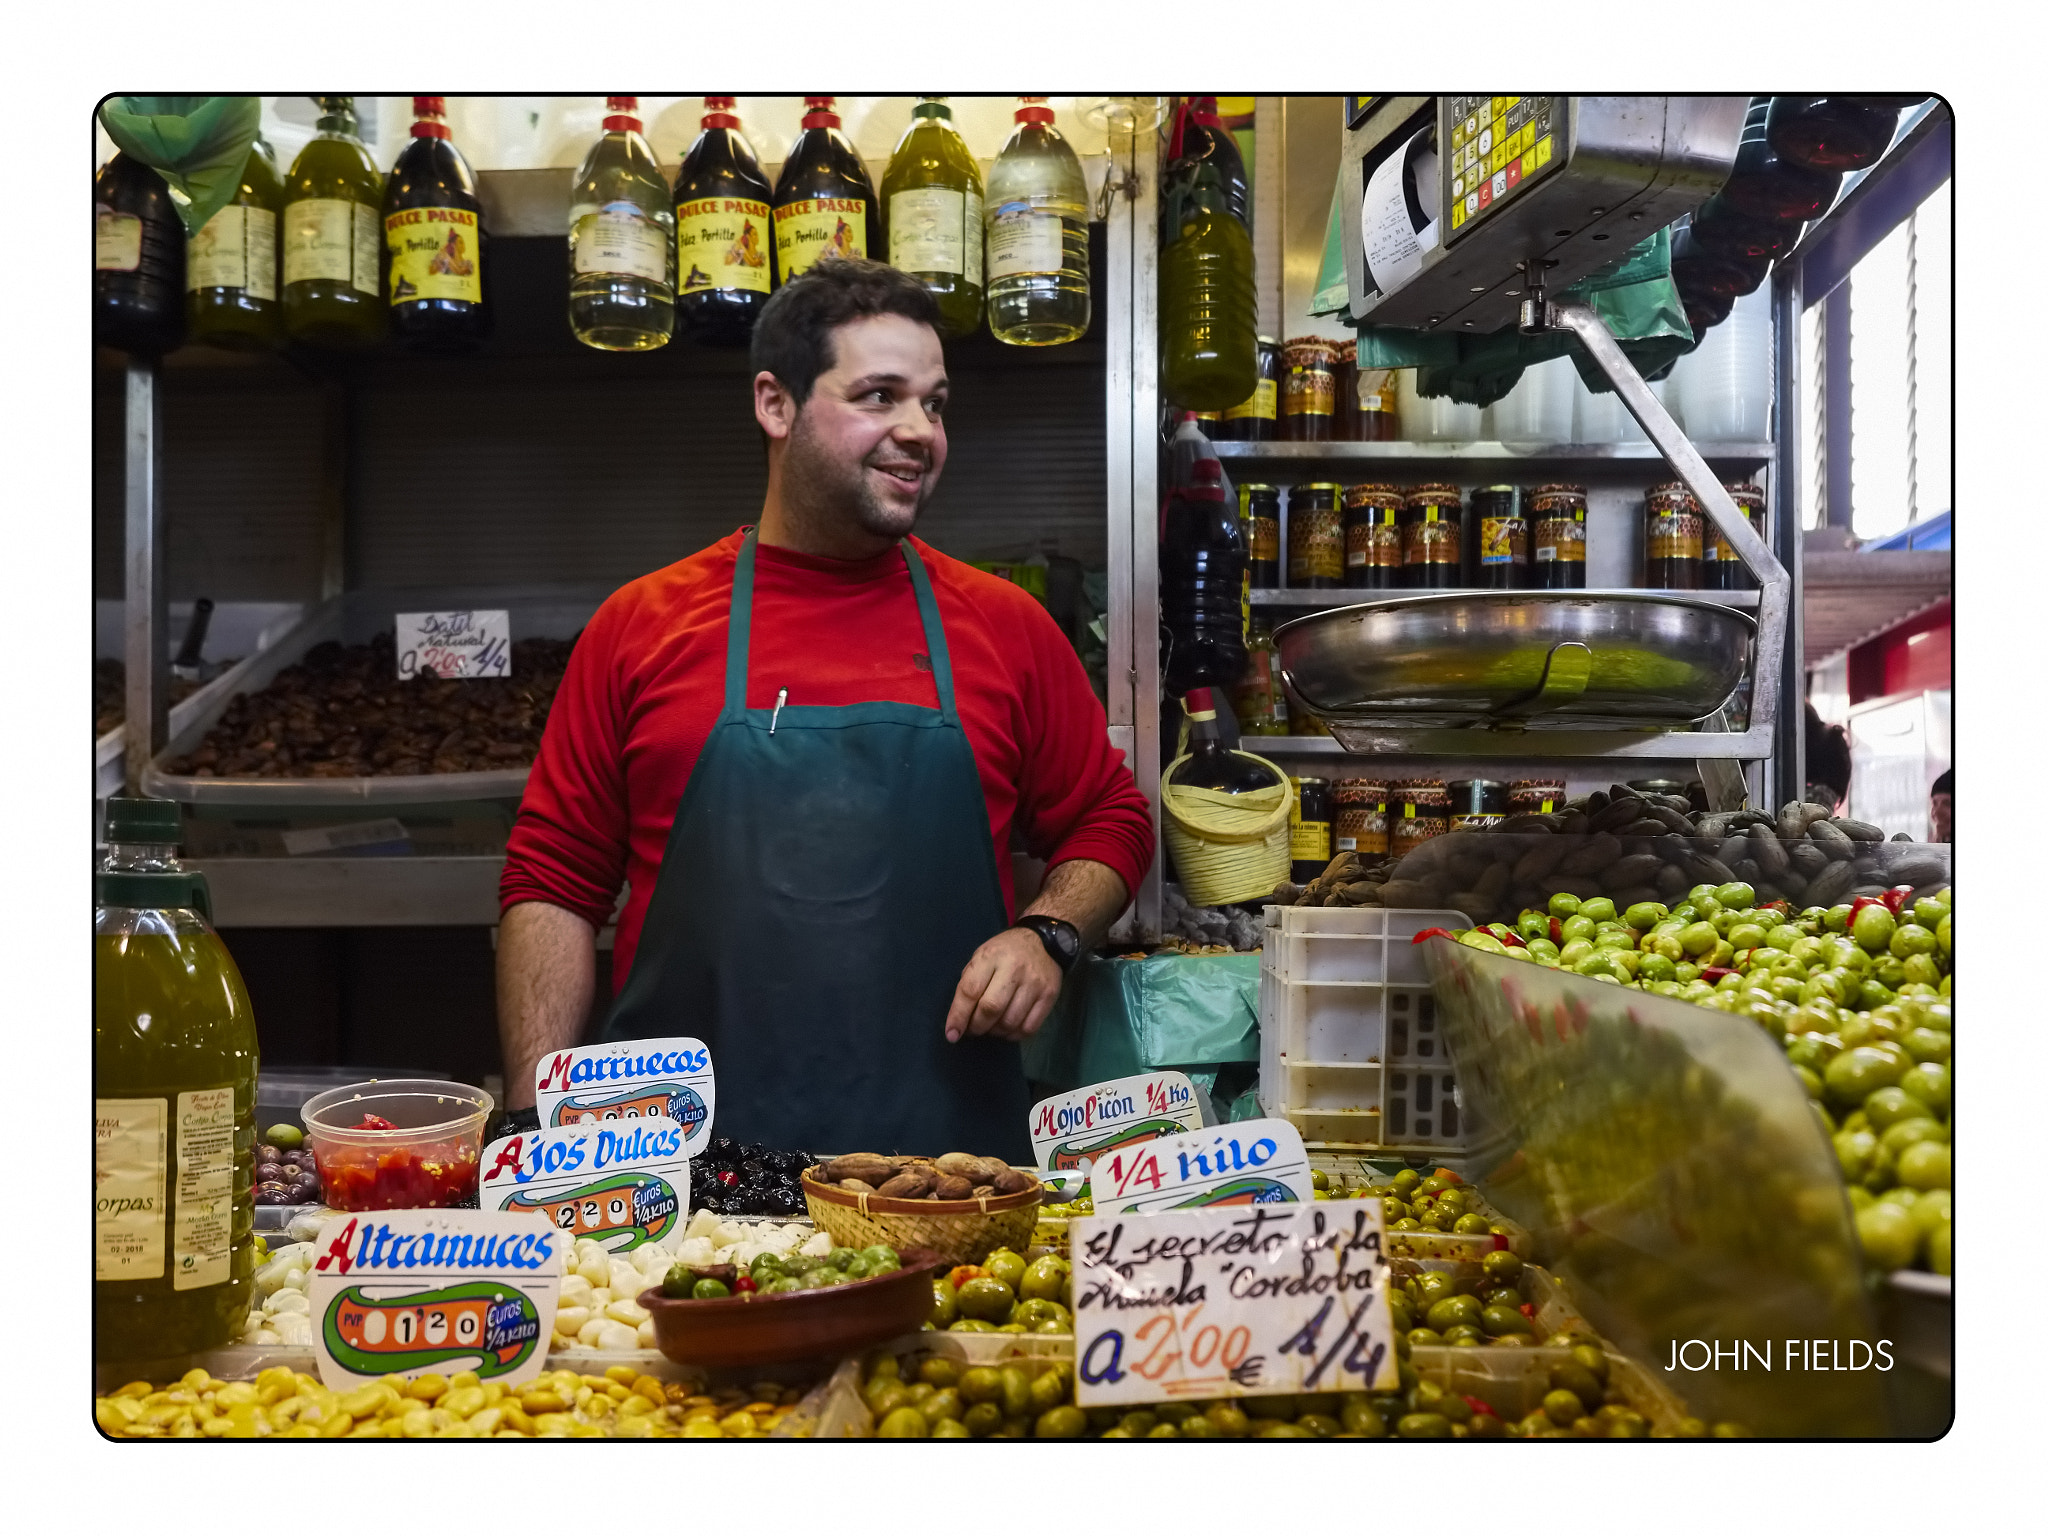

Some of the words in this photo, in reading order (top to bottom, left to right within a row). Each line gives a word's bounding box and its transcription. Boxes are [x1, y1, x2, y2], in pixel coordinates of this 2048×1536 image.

[678, 201, 719, 219] DULCE
[724, 200, 768, 219] PASAS
[774, 201, 811, 223] DULCE
[816, 199, 862, 214] PASAS
[1482, 189, 1488, 200] C
[387, 210, 422, 231] DULCE
[427, 210, 474, 226] PASAS
[701, 228, 735, 242] Portillo
[796, 228, 828, 243] Portillo
[538, 1048, 708, 1091] Marruecos
[484, 1134, 588, 1184] Ajos
[594, 1127, 682, 1170] Dulces
[1107, 1148, 1168, 1198] 1/4
[315, 1217, 555, 1275] Altramuces
[1131, 1208, 1294, 1258] secreto
[1278, 1294, 1387, 1389] 1/4
